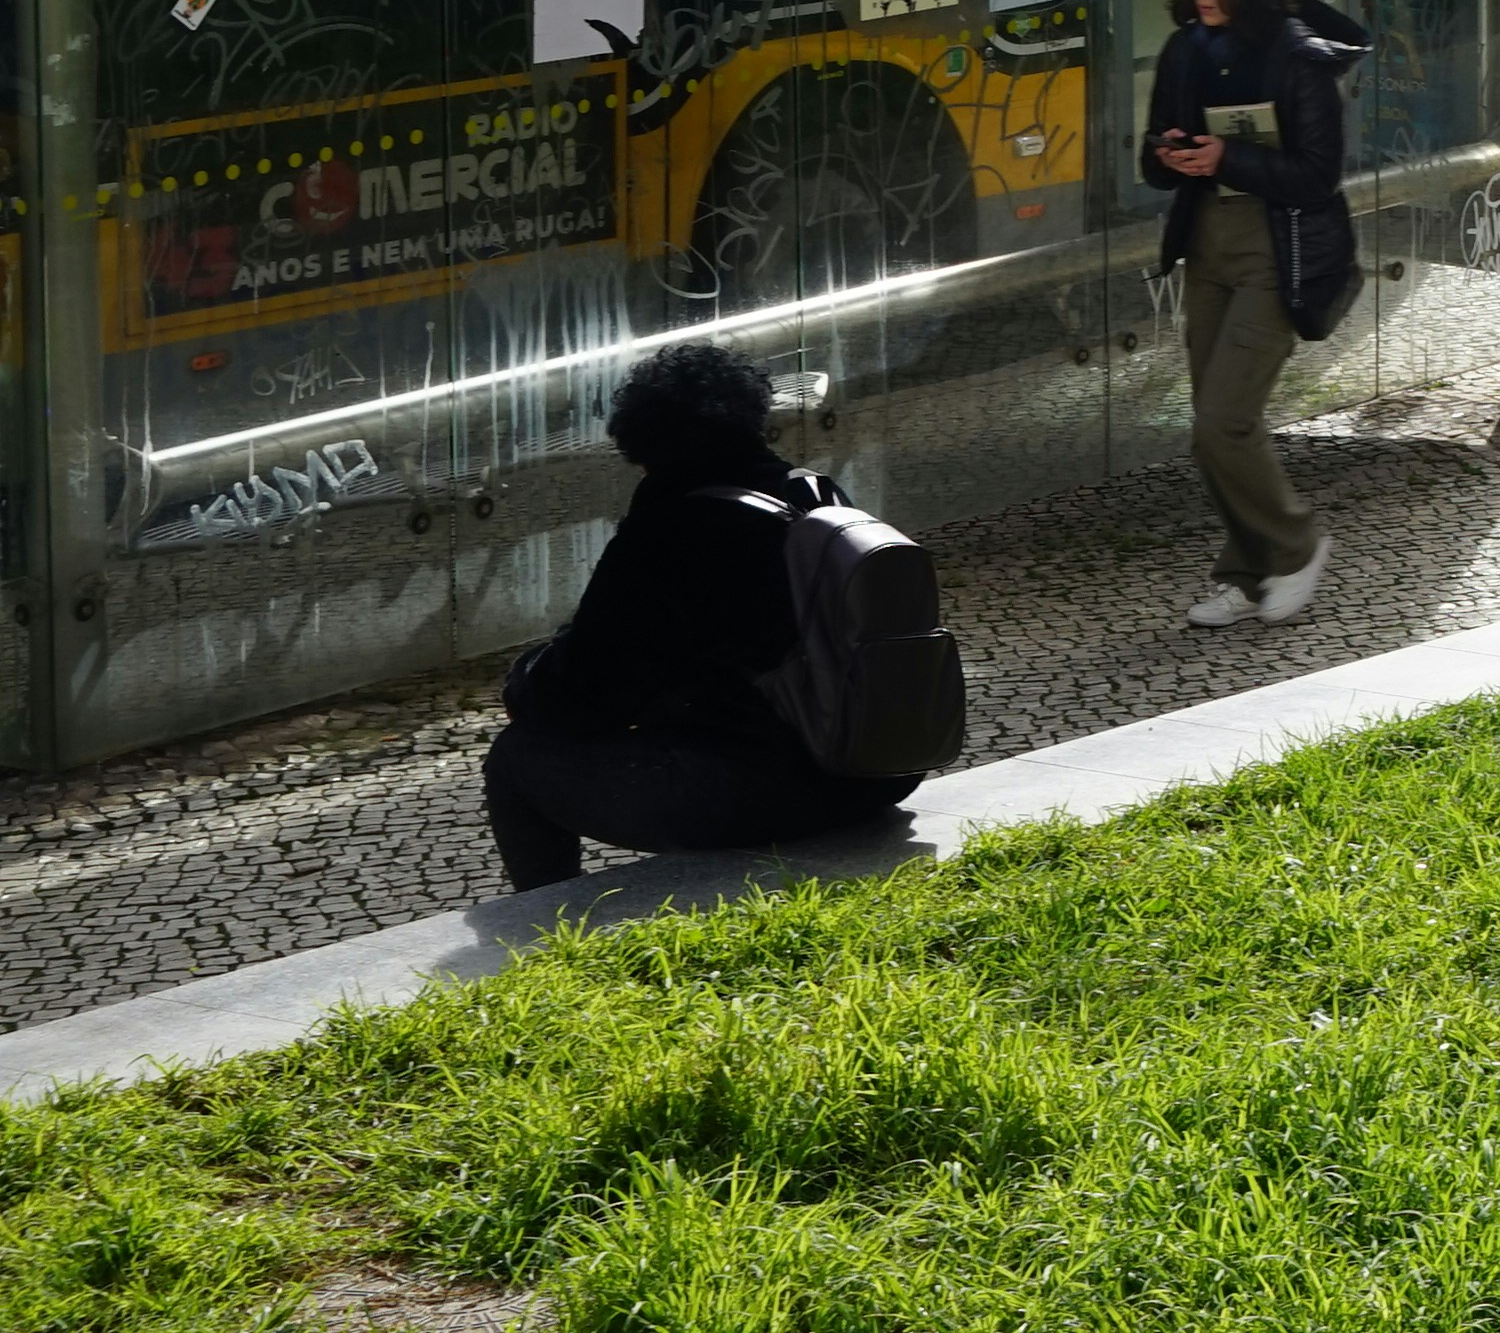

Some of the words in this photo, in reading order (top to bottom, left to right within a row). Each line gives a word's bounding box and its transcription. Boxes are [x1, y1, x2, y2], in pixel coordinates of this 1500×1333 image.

[467, 100, 578, 148] RÁDIO
[231, 253, 322, 292] ANOS
[333, 249, 350, 273] E
[362, 236, 427, 268] NEM
[437, 223, 506, 255] UMA
[515, 206, 606, 242] RUGA!
